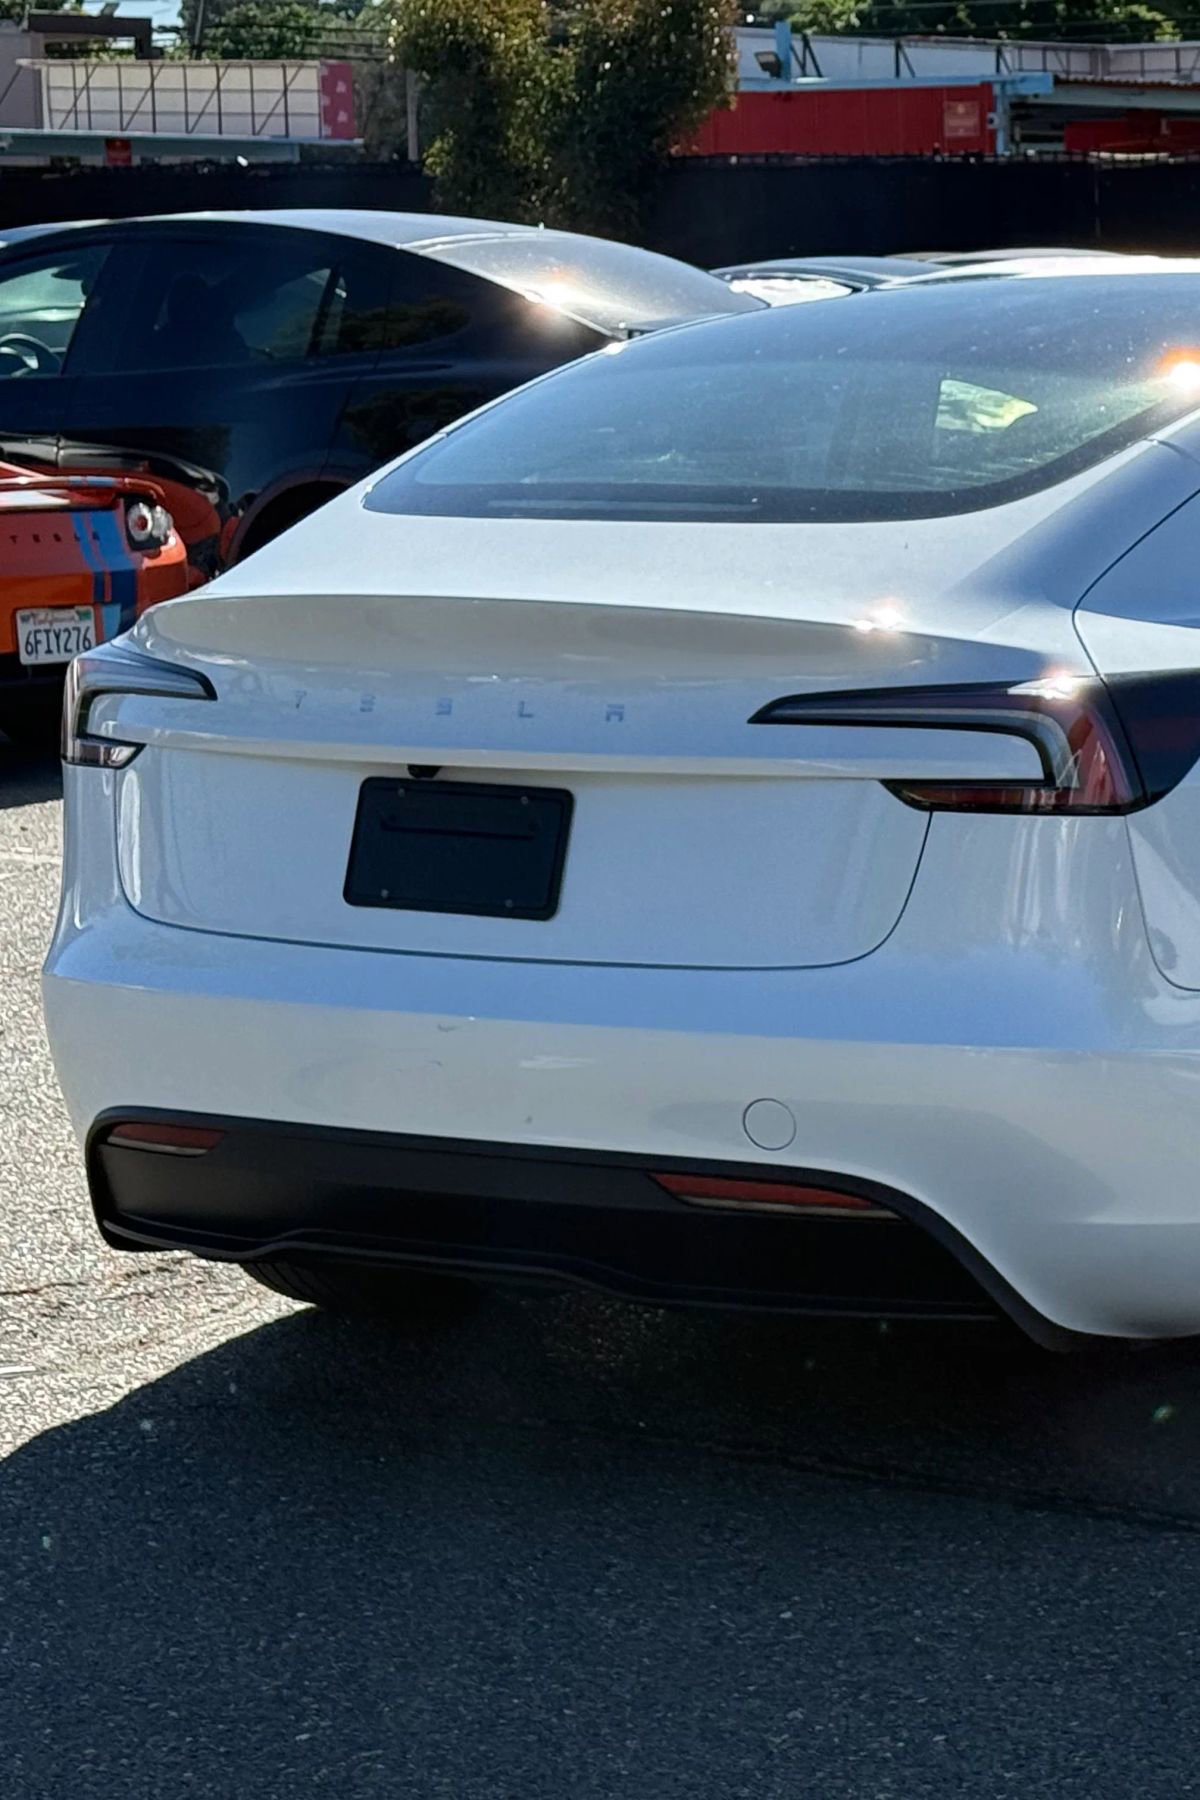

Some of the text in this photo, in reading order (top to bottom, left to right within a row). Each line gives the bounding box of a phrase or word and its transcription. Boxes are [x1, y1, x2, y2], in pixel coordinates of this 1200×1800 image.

[9, 532, 101, 544] TESLA
[25, 626, 92, 656] 6FIY276
[294, 690, 626, 722] TESLA
